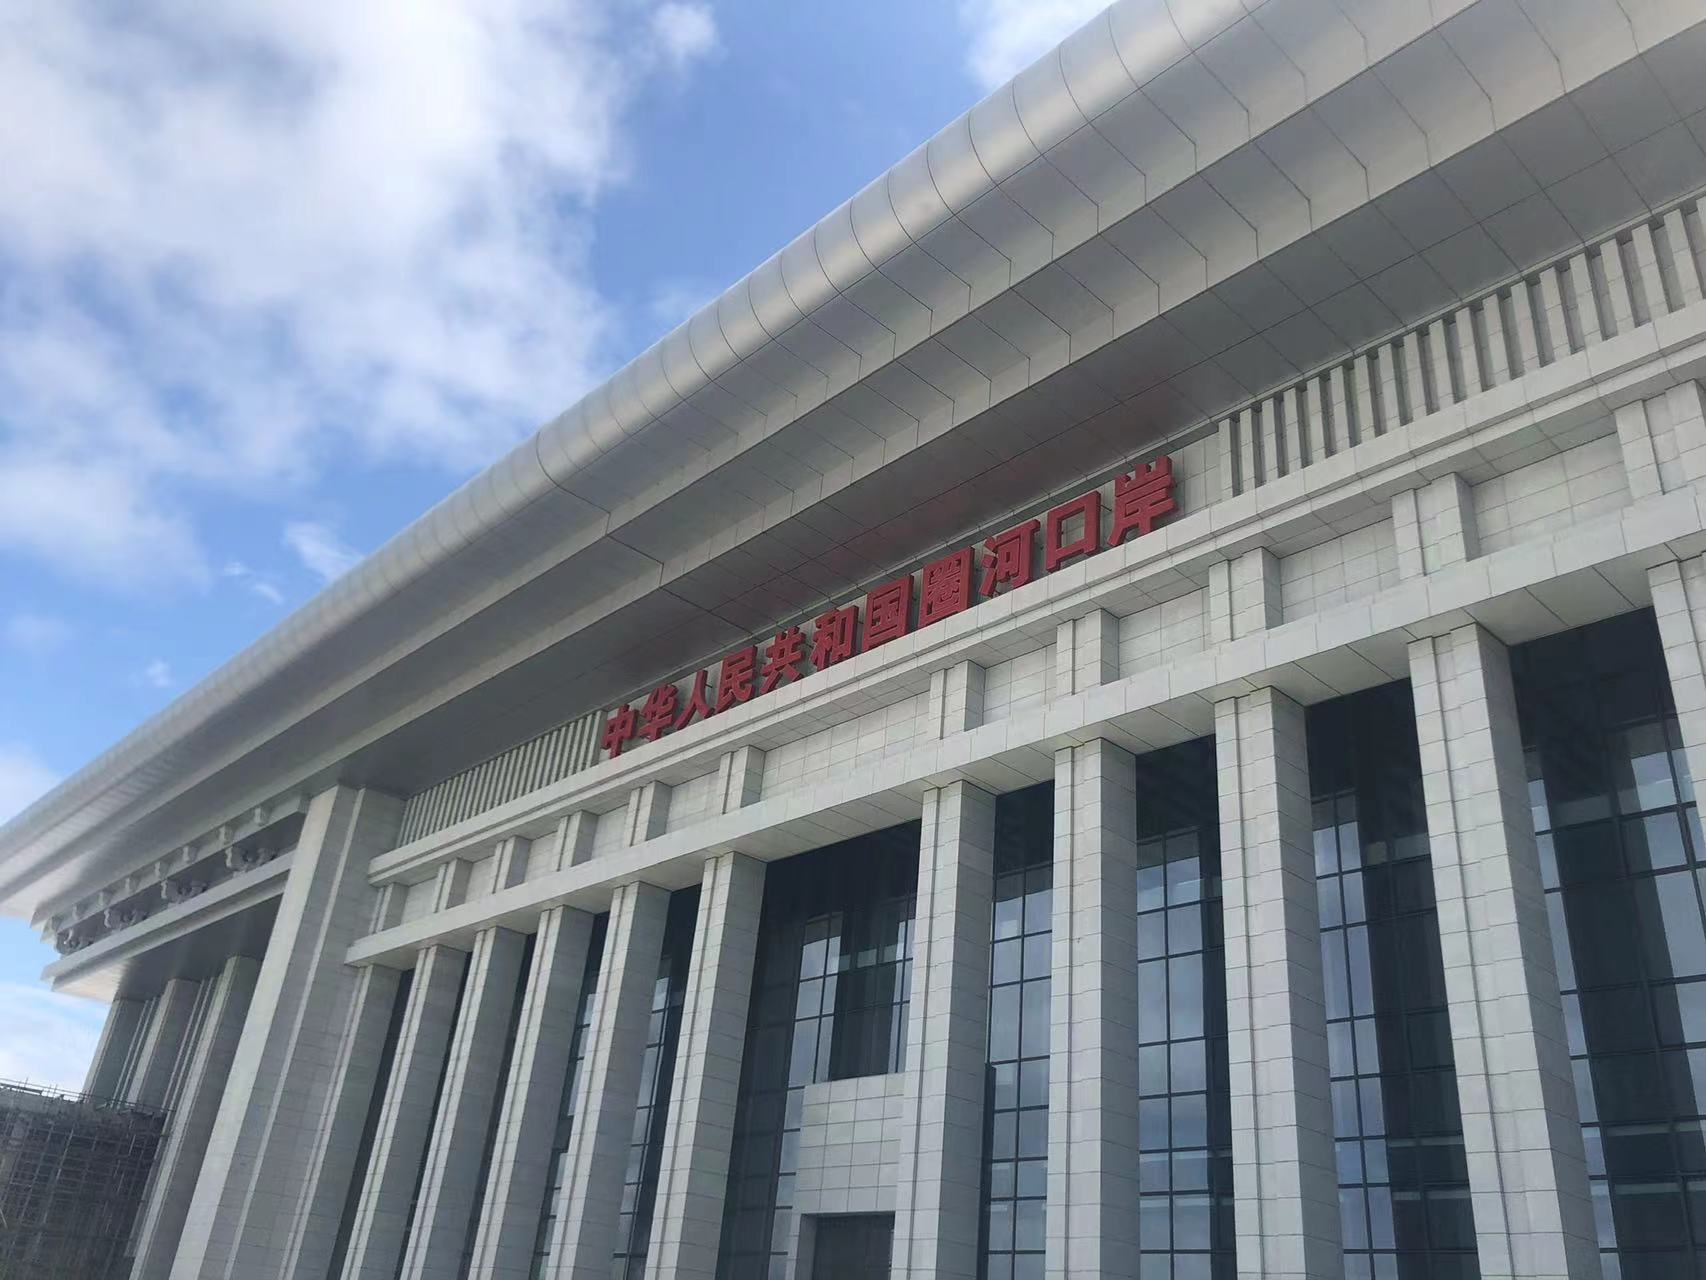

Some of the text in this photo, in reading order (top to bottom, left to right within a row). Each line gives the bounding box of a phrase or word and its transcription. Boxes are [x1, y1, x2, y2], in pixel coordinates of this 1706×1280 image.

[602, 456, 1176, 758] 中华人民共和国圈河口岸
